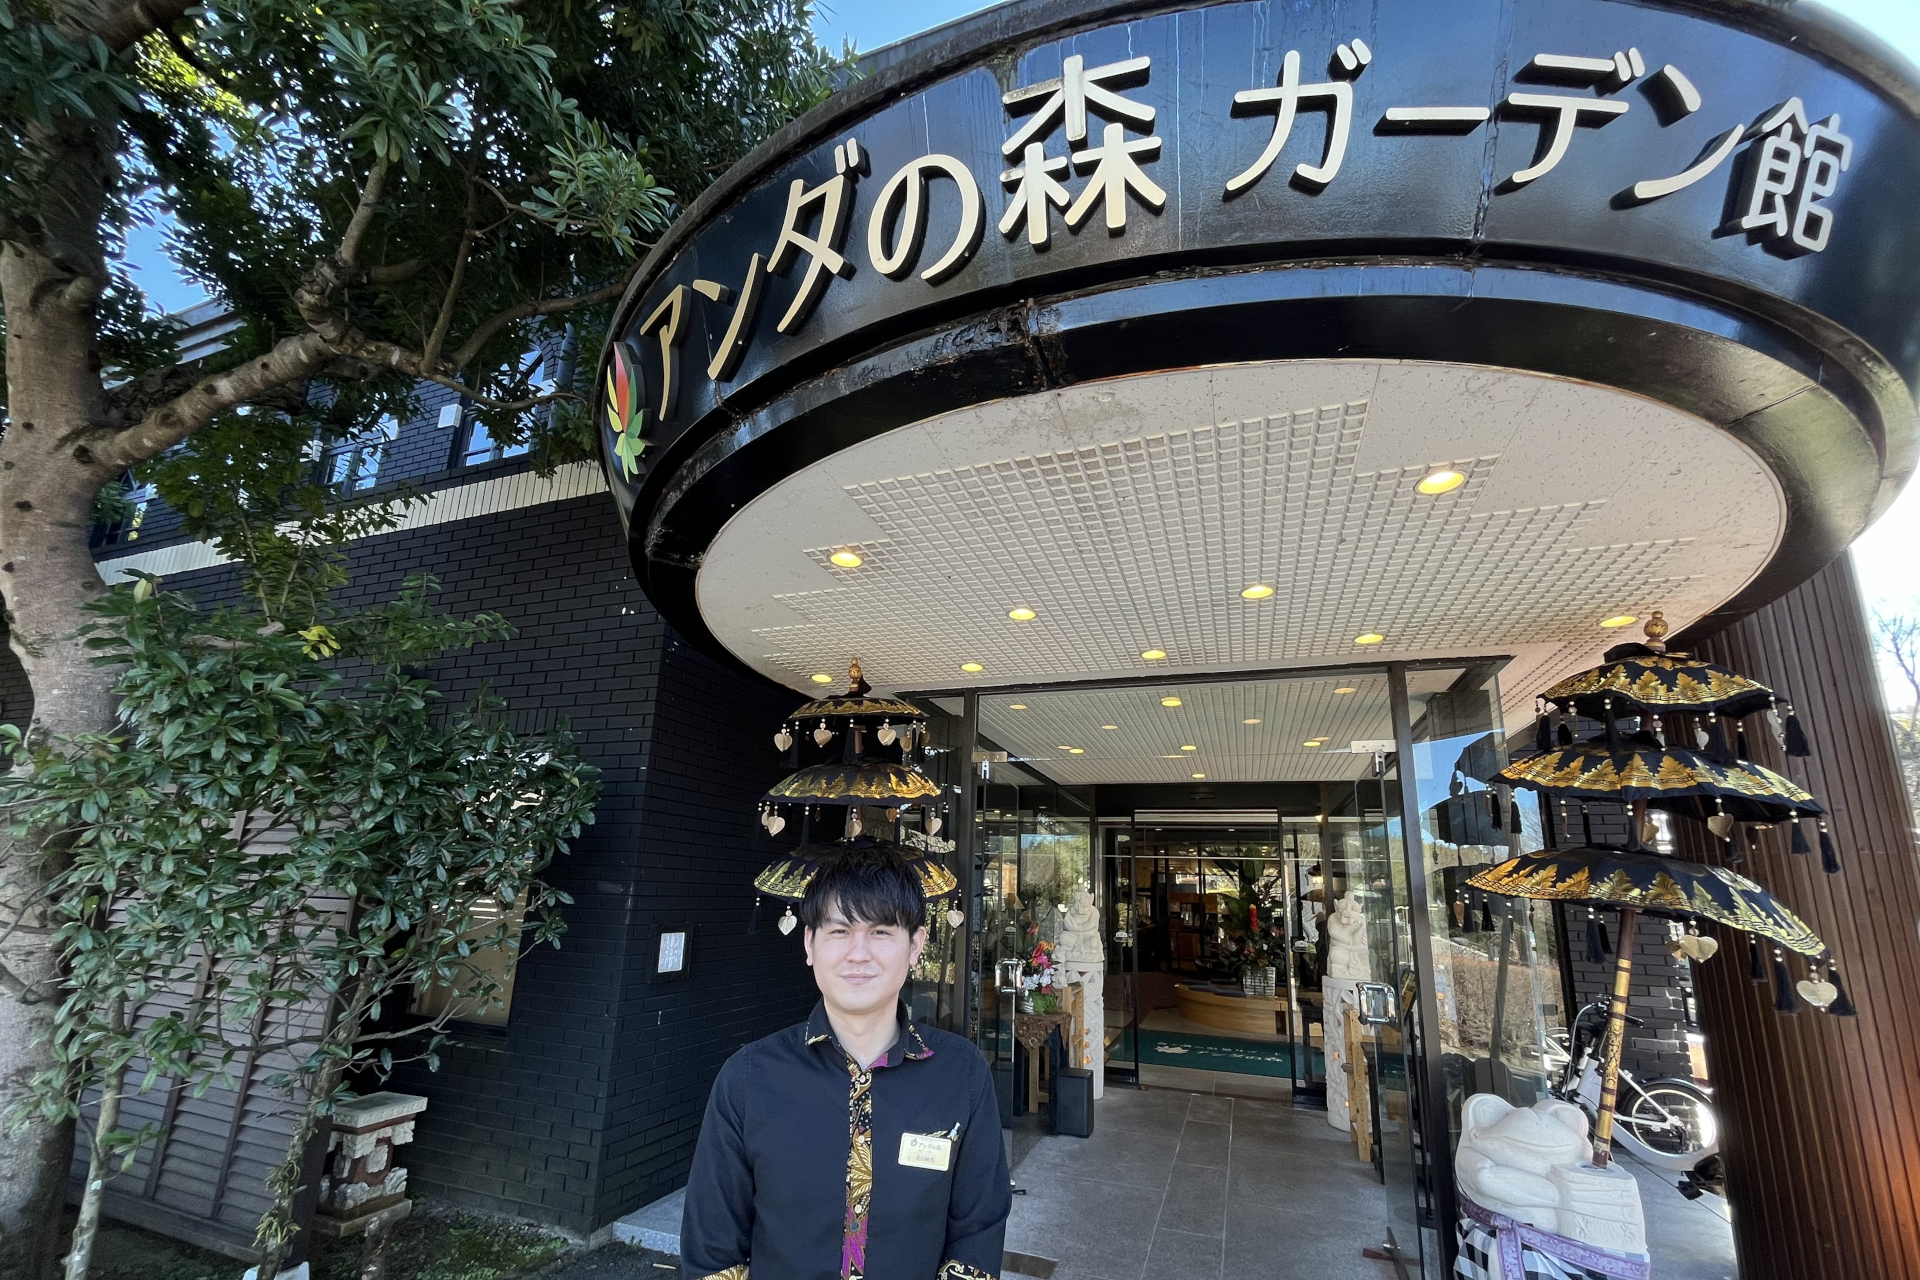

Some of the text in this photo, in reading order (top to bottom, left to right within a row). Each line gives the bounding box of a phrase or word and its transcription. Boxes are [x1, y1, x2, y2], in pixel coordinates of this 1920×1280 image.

[640, 38, 1853, 421] アンダの森 ガーデン館
